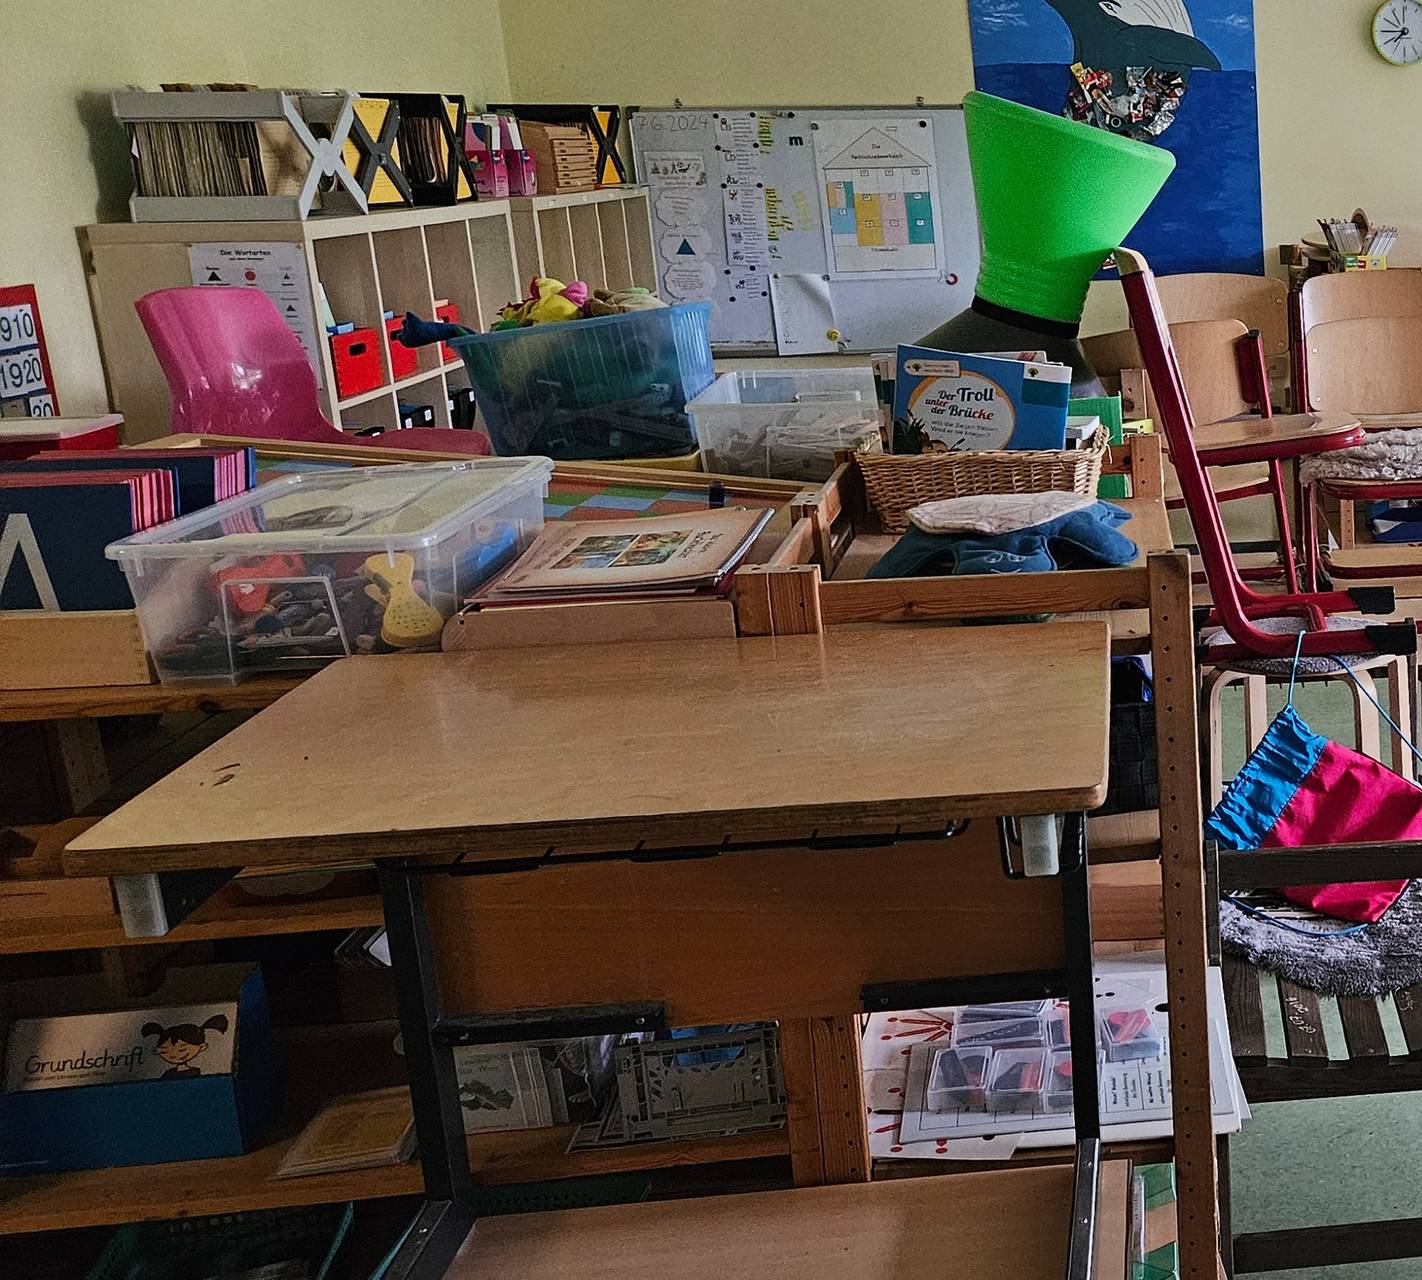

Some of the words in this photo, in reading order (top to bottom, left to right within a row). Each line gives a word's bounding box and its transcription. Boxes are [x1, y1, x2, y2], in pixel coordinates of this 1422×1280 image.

[925, 398, 948, 407] unter
[938, 389, 956, 401] Der
[956, 387, 994, 402] Troll
[930, 407, 946, 415] der
[948, 404, 994, 421] Brücke
[0, 513, 61, 612] A
[25, 1047, 144, 1073] Grundschrift
